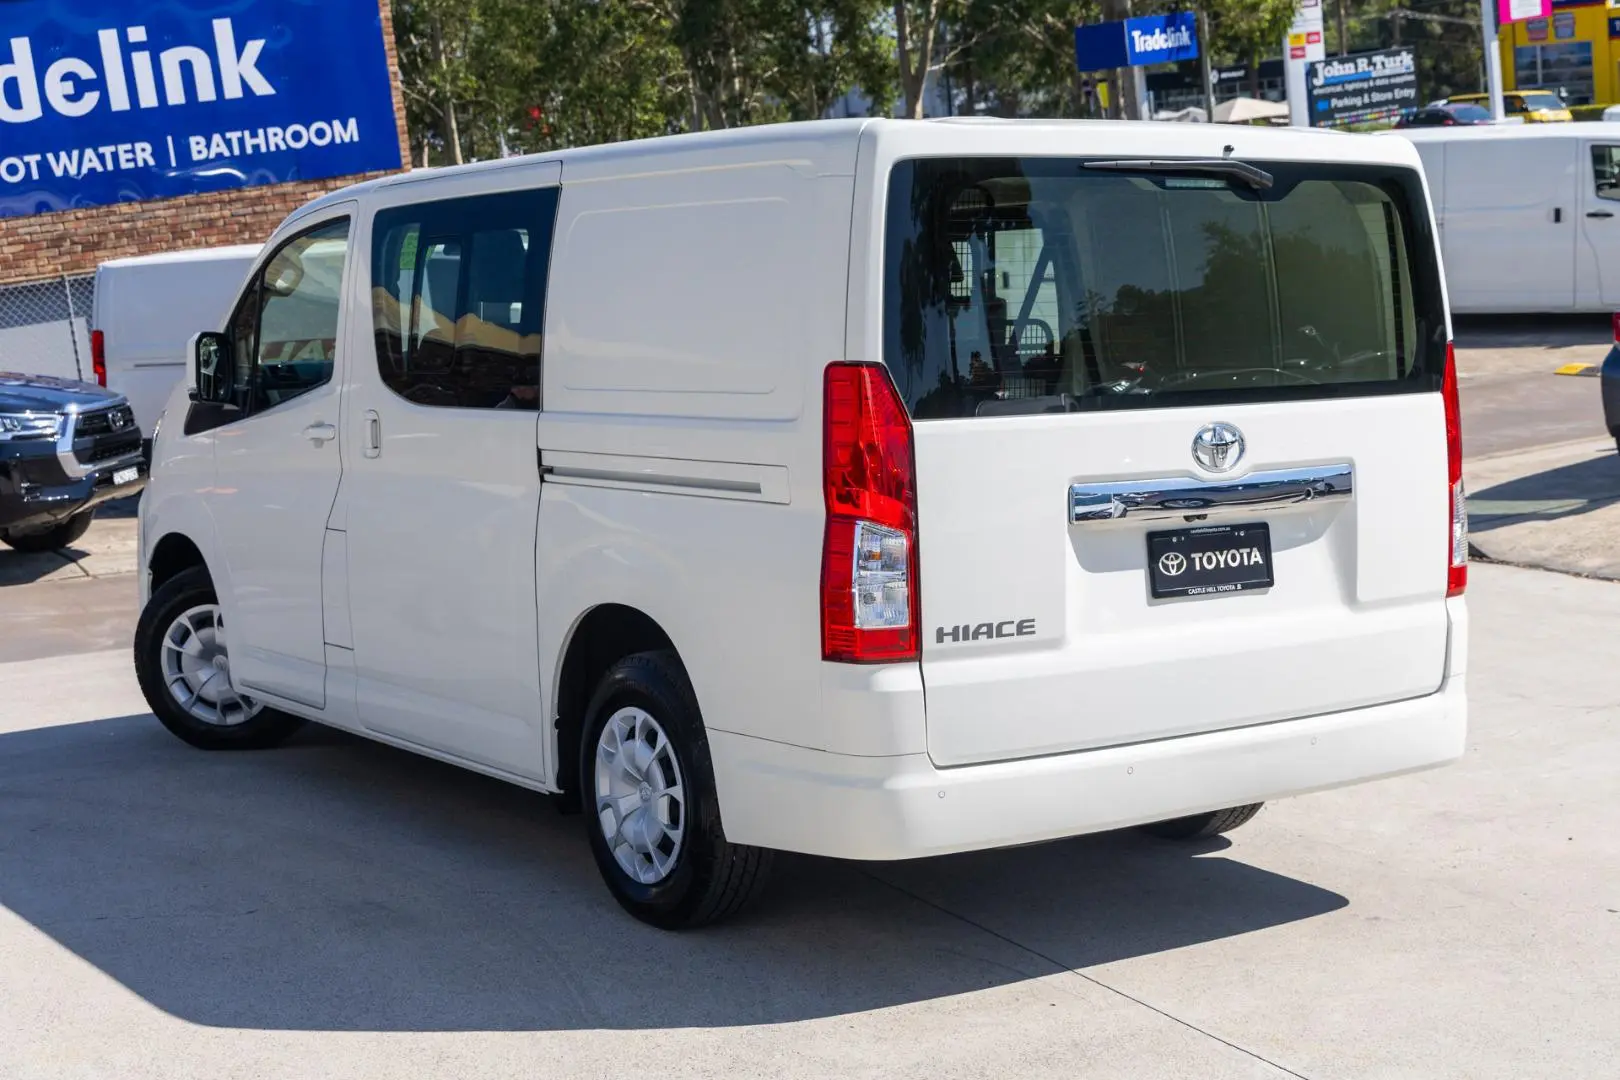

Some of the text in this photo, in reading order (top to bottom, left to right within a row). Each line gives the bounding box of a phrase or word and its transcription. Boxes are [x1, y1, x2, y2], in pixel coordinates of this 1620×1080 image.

[1131, 25, 1191, 53] Tradelink
[1312, 61, 1356, 86] John
[1372, 50, 1414, 71] Turk
[1330, 88, 1416, 108] Parking & Store Entry
[0, 117, 360, 184] OT WATER BATHROOM
[1191, 547, 1263, 571] TOYOTA
[1188, 587, 1206, 595] CASTLE
[1217, 584, 1235, 592] TOYOTA
[936, 618, 1036, 644] HIACE
